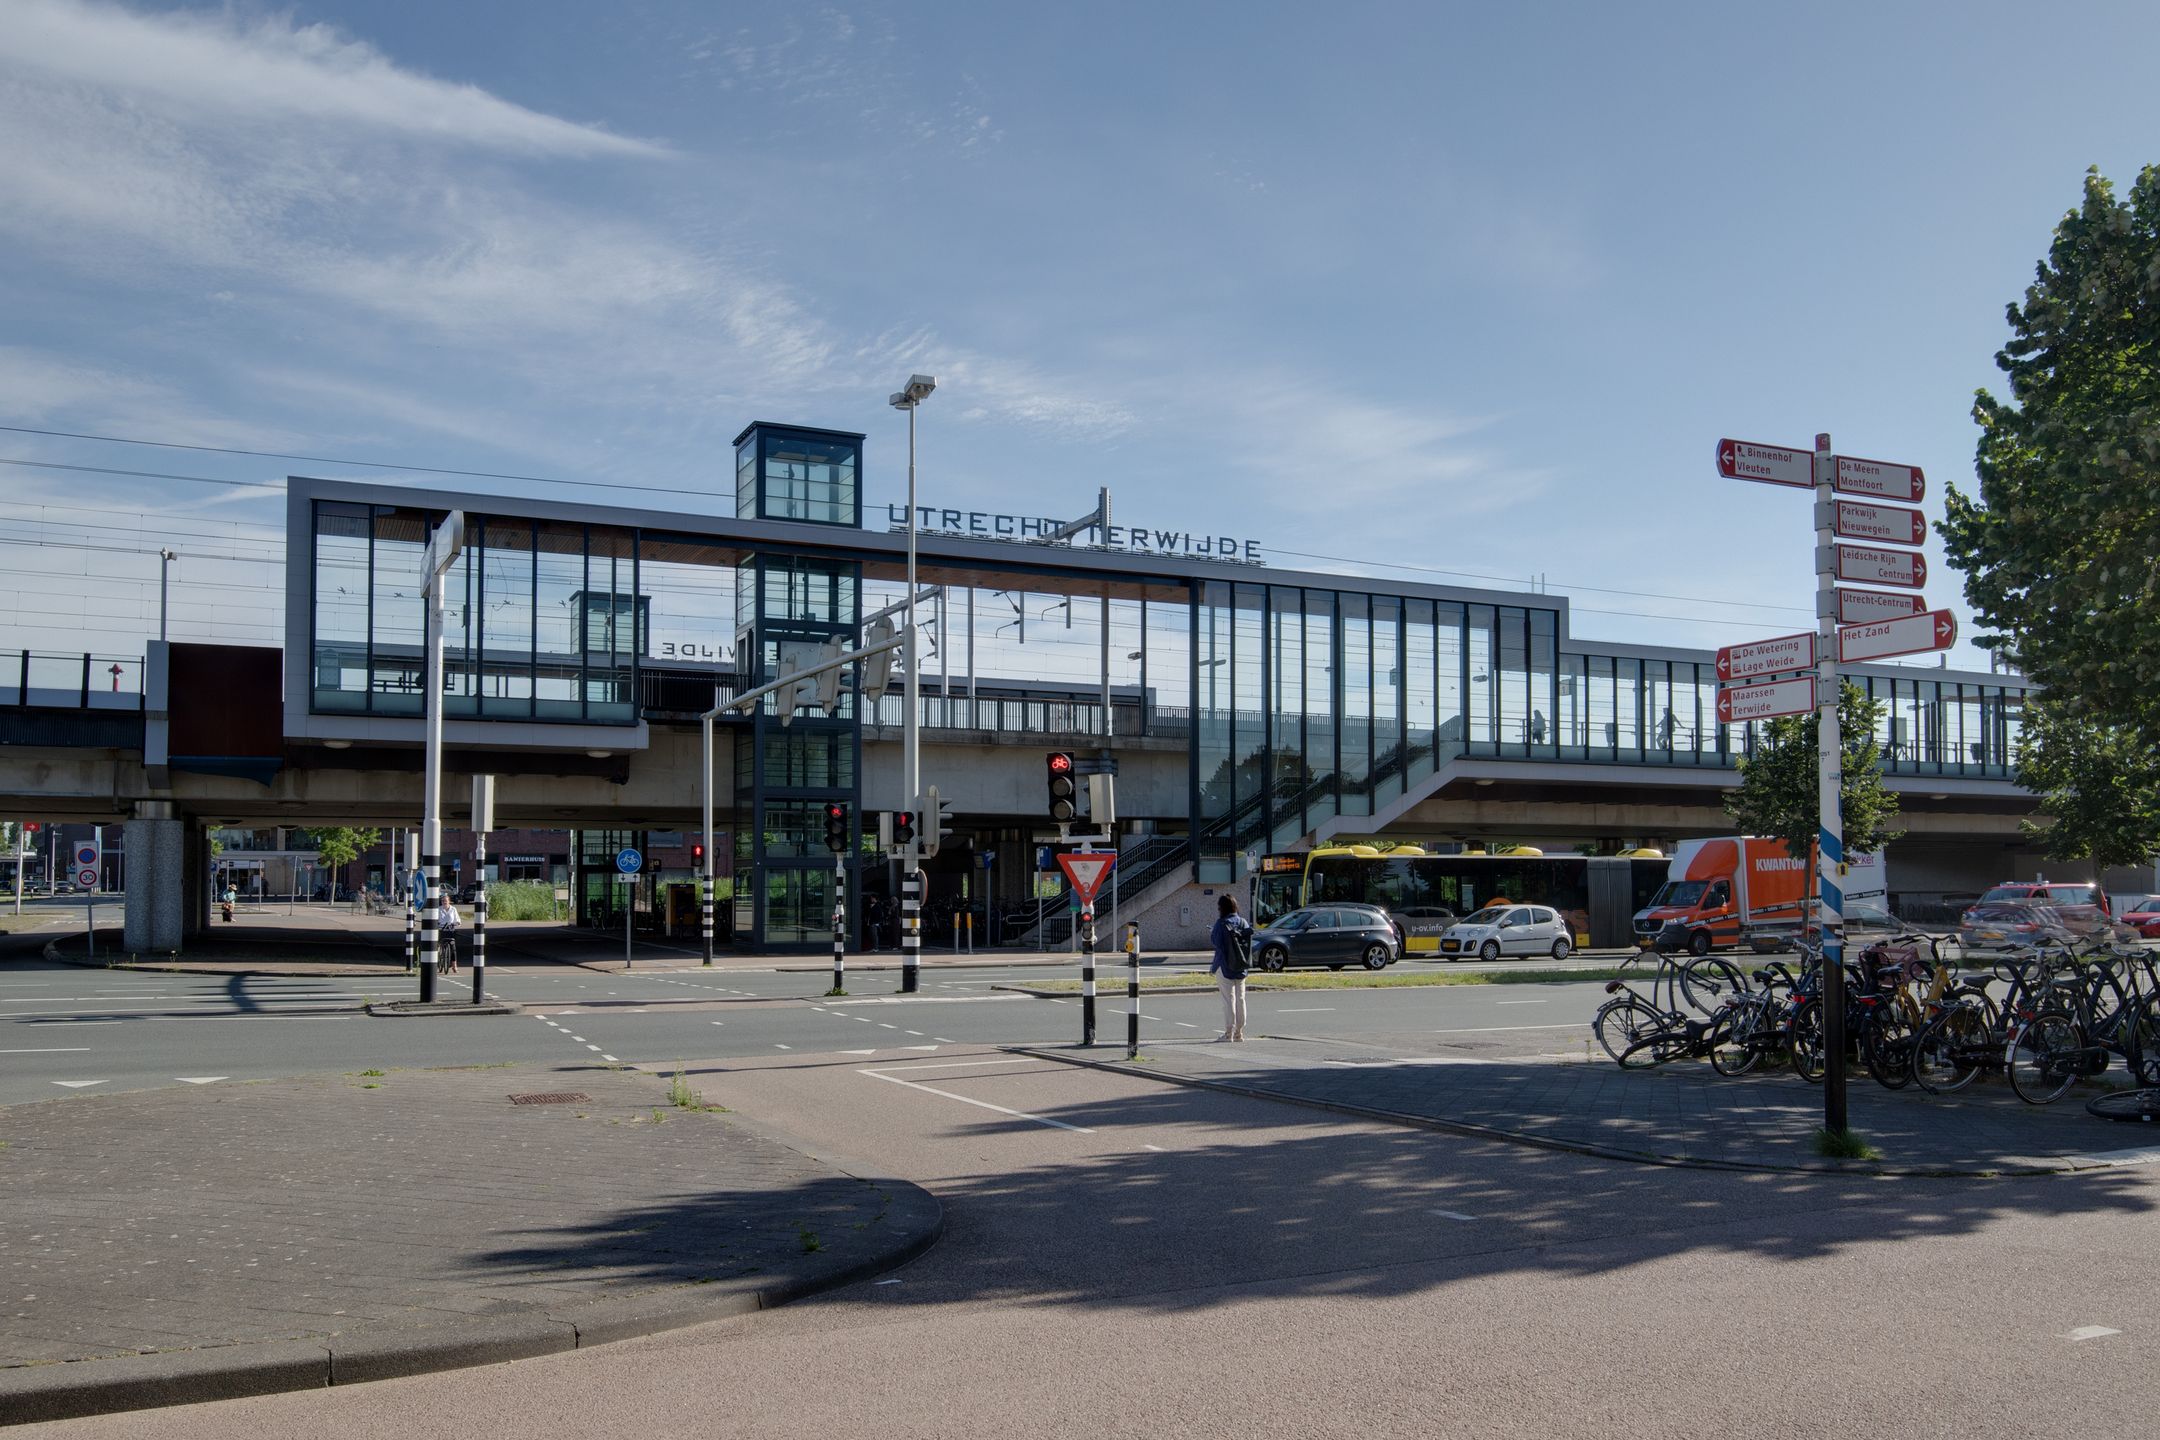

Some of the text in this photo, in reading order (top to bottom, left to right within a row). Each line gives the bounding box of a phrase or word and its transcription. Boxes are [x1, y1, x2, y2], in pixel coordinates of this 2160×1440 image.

[1748, 447, 1792, 462] Binnenhof
[1737, 461, 1771, 475] Vleuten
[1840, 461, 1880, 475] De Meern
[1841, 476, 1883, 490] Montfoort
[1841, 505, 1877, 520] Parkwijk
[889, 503, 1067, 539] UTRECHT
[1841, 520, 1890, 535] Nieuwegein
[1842, 549, 1896, 565] Leidsche Rijn
[1878, 568, 1912, 580] Centrum
[1843, 593, 1912, 608] Utrecht-Centrum
[1844, 624, 1890, 640] Het Zand
[1742, 641, 1799, 658] De Wetering
[1743, 657, 1795, 672] Lage Weide
[1732, 688, 1775, 701] Maarssen
[1733, 702, 1771, 715] Terwijde
[1411, 923, 1444, 932] u-ov.info
